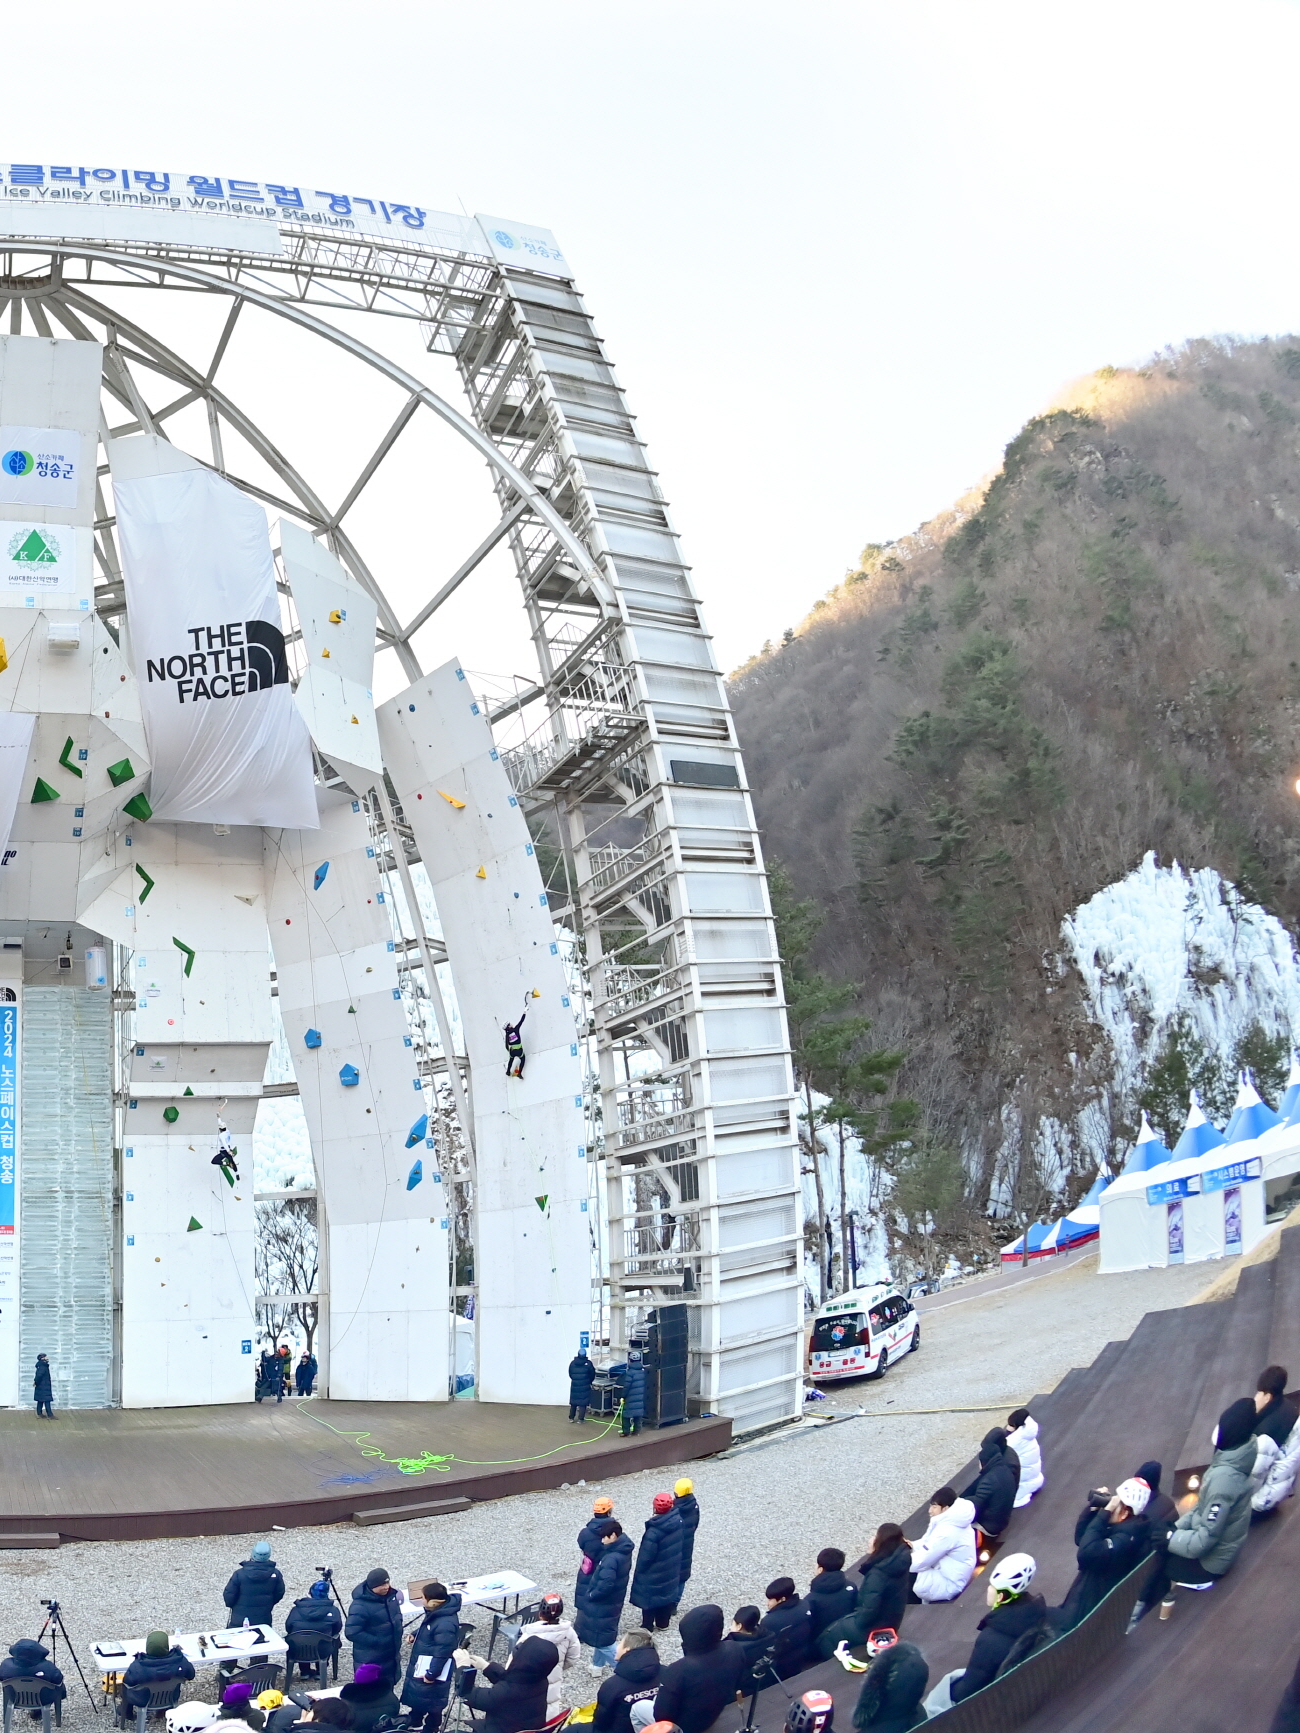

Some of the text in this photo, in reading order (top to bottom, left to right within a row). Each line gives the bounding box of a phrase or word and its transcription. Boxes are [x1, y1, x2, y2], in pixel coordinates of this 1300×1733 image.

[4, 186, 30, 197] Ice
[36, 186, 93, 200] Valley
[100, 190, 180, 208] Climbing
[187, 196, 276, 218] Worldcup
[282, 206, 356, 228] Stadium
[187, 175, 304, 210] 월드컵
[315, 190, 426, 230] 경기장
[522, 242, 564, 262] 청송군
[37, 453, 64, 462] 산소카페
[36, 461, 74, 480] 청송군
[20, 551, 28, 560] K
[188, 622, 244, 650] THE
[147, 647, 246, 682] NORTH
[177, 672, 246, 704] FACE
[0, 1010, 14, 1184] 2024 노스페이스컵 청송
[1218, 1164, 1246, 1180] 시스템운영
[634, 1687, 659, 1700] DESCE
